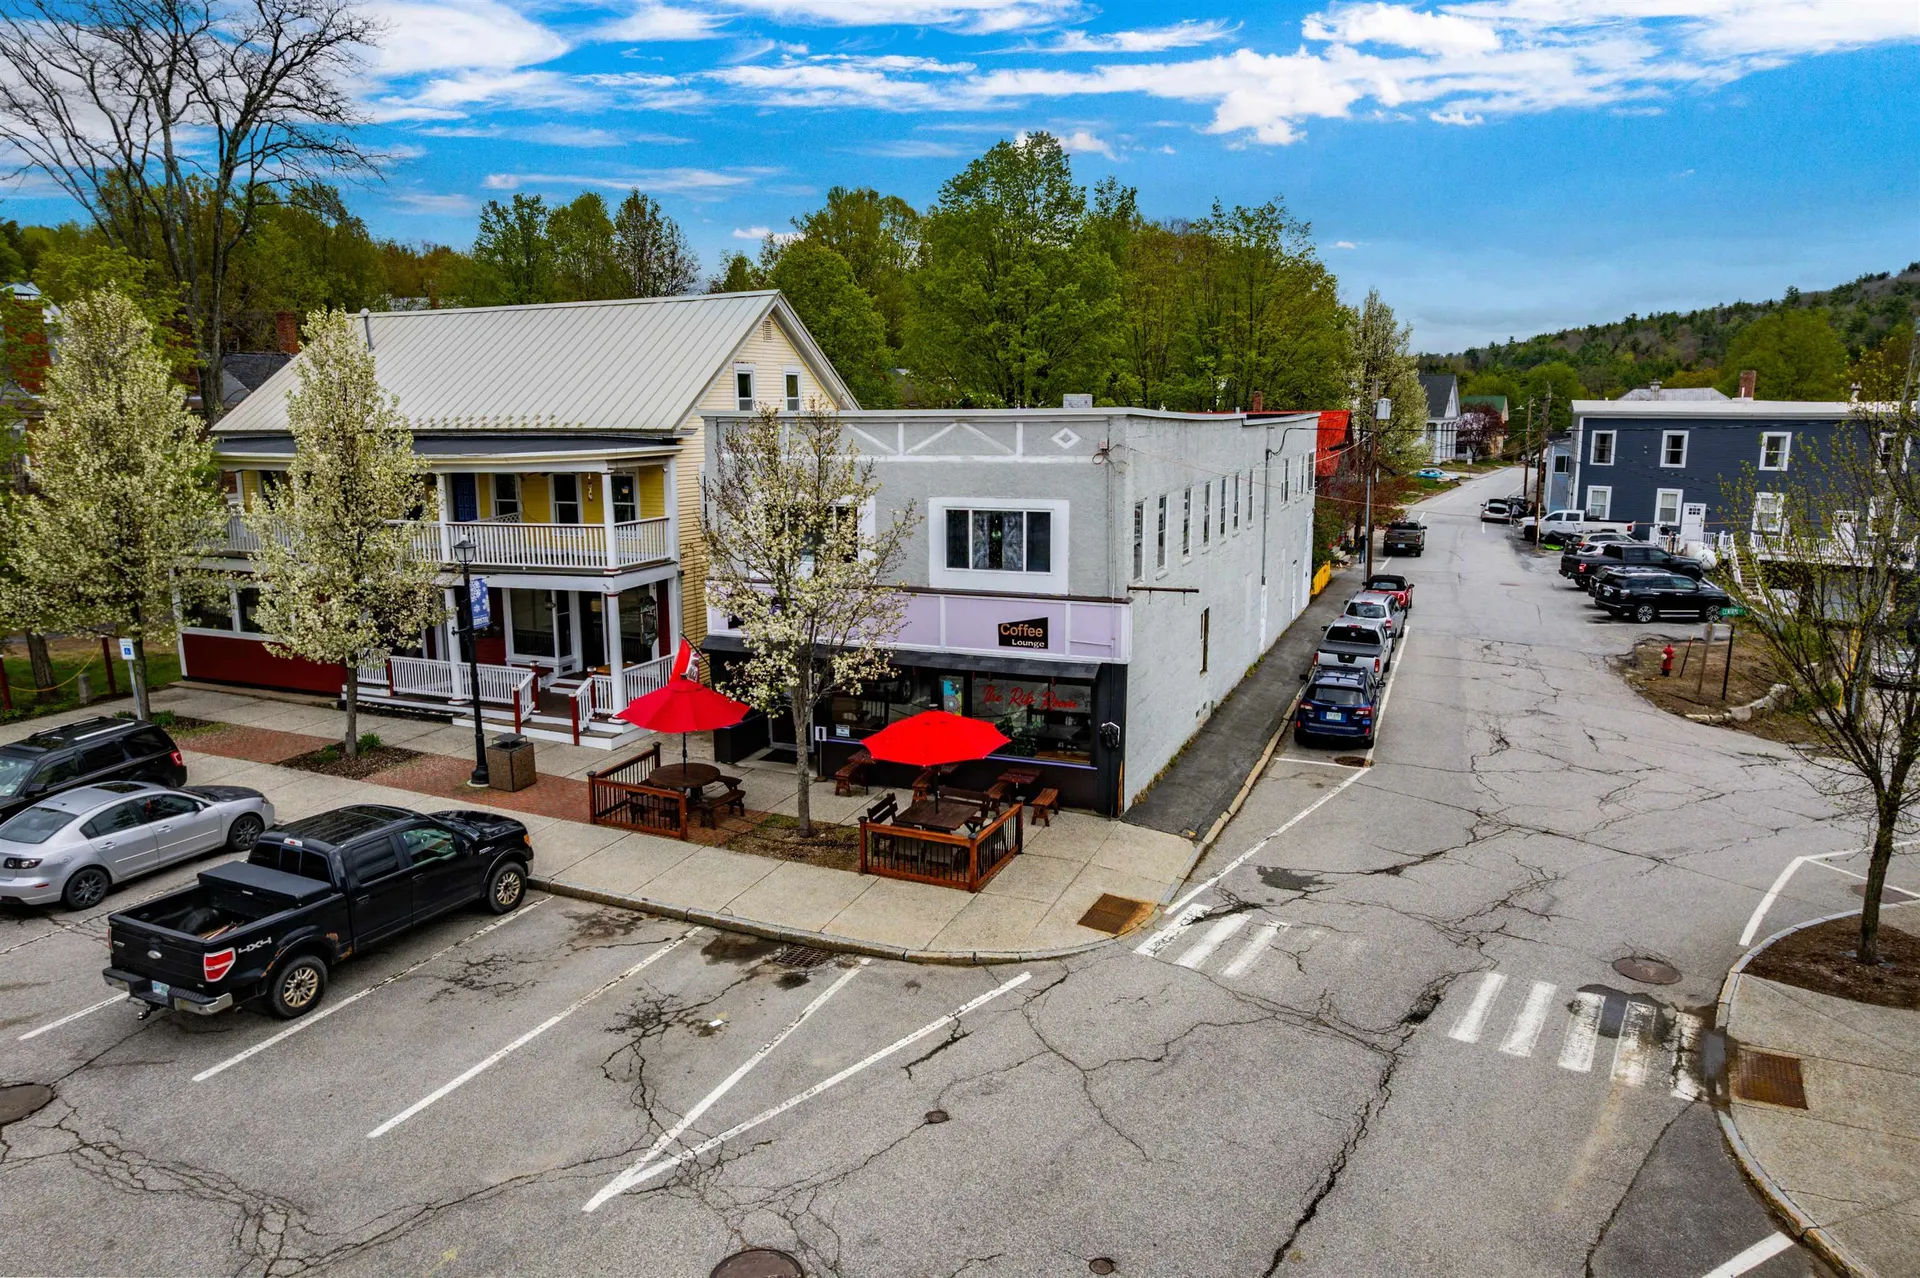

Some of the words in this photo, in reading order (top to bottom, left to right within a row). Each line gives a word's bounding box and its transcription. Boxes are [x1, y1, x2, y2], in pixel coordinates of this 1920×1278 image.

[1000, 623, 1044, 638] Coffee
[1011, 638, 1045, 649] Lounge
[983, 685, 1004, 704] The
[1008, 686, 1036, 707] Rib
[1039, 690, 1078, 711] Room
